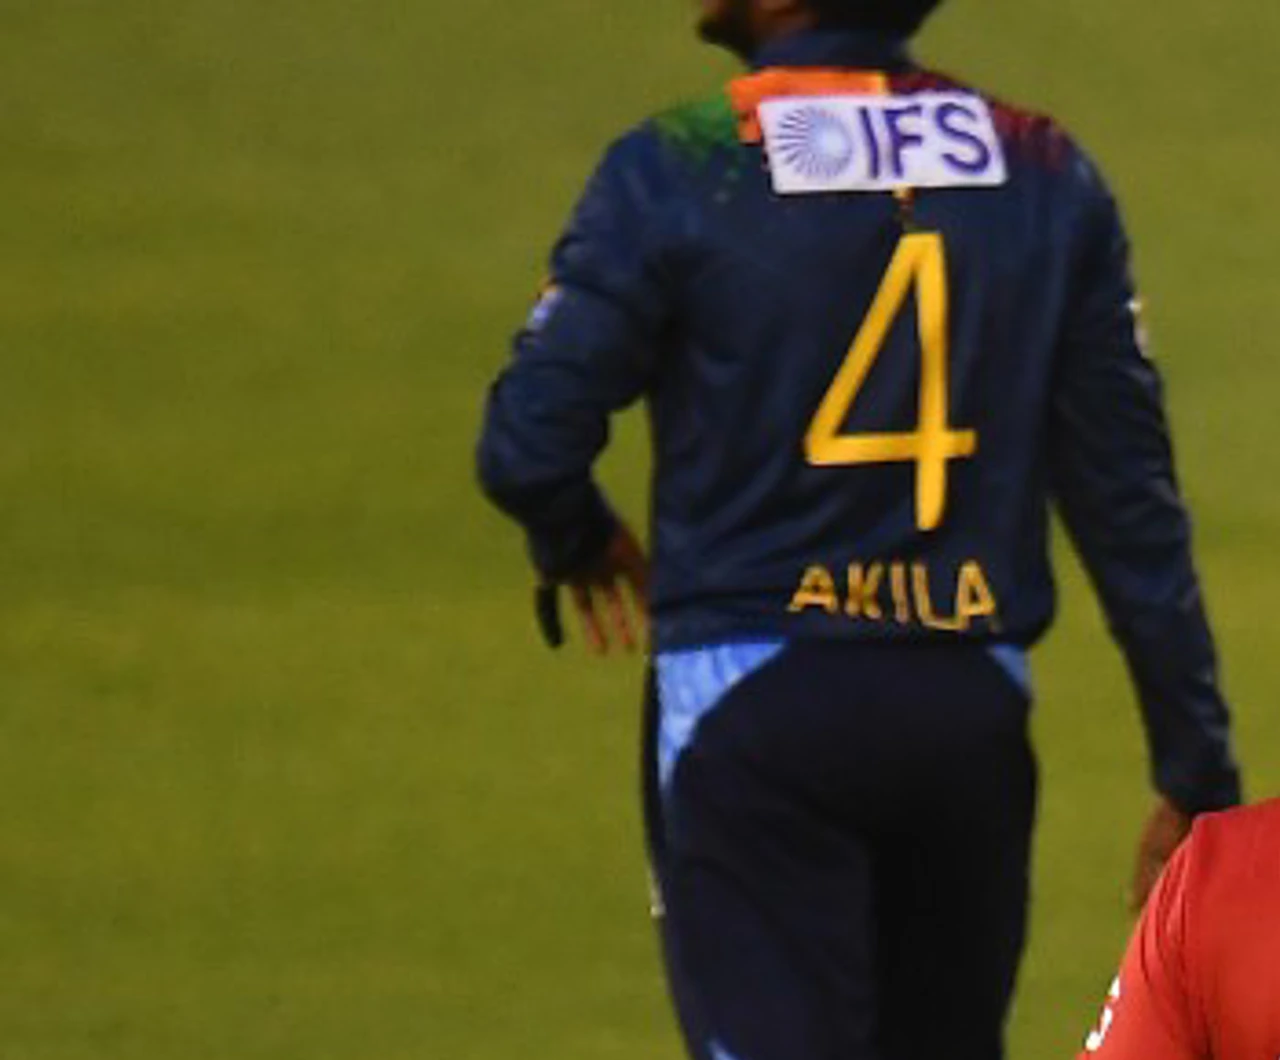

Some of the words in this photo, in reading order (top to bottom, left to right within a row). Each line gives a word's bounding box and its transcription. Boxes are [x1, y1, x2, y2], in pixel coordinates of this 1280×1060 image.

[858, 101, 991, 180] IFS
[804, 231, 977, 532] 4
[786, 558, 1002, 633] AKILA
